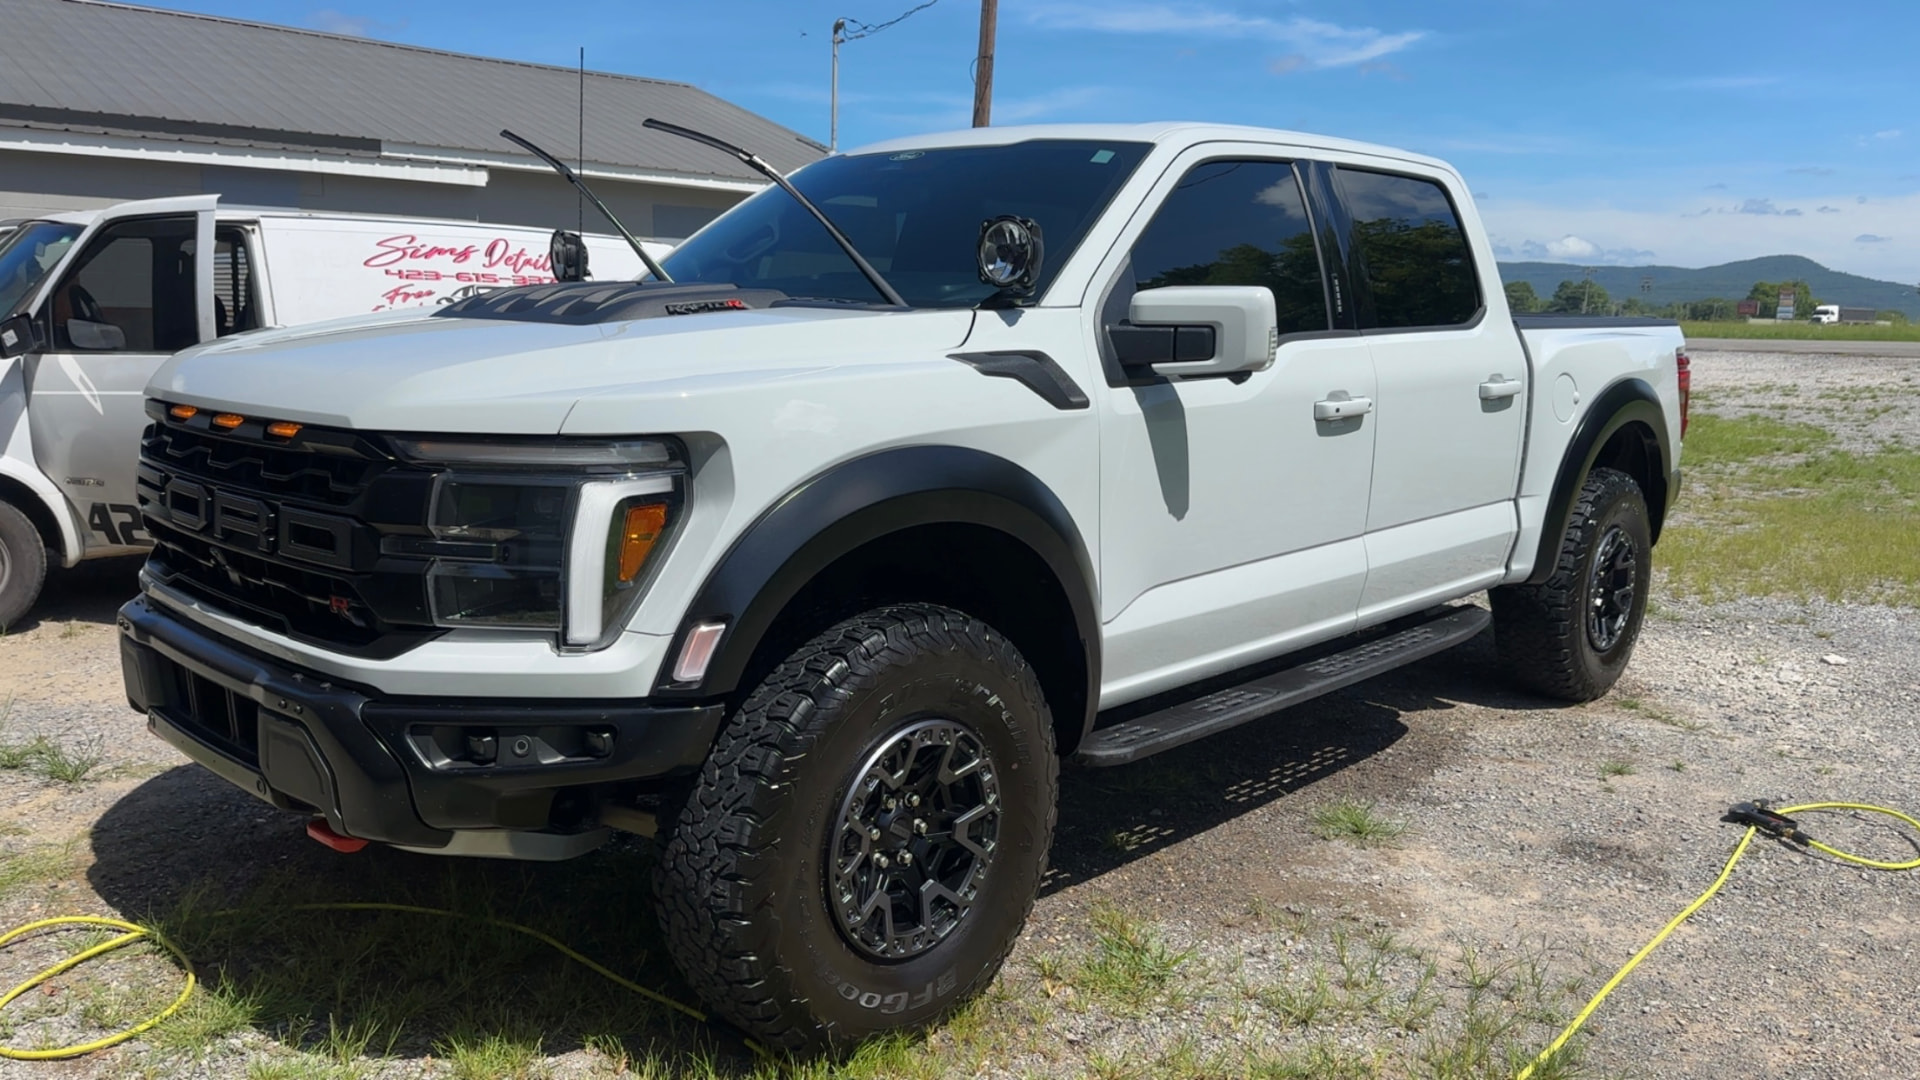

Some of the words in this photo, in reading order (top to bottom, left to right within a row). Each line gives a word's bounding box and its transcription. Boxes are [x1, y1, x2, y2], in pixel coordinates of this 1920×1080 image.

[363, 234, 480, 268] Sims
[381, 284, 435, 305] Free
[88, 502, 155, 546] 42
